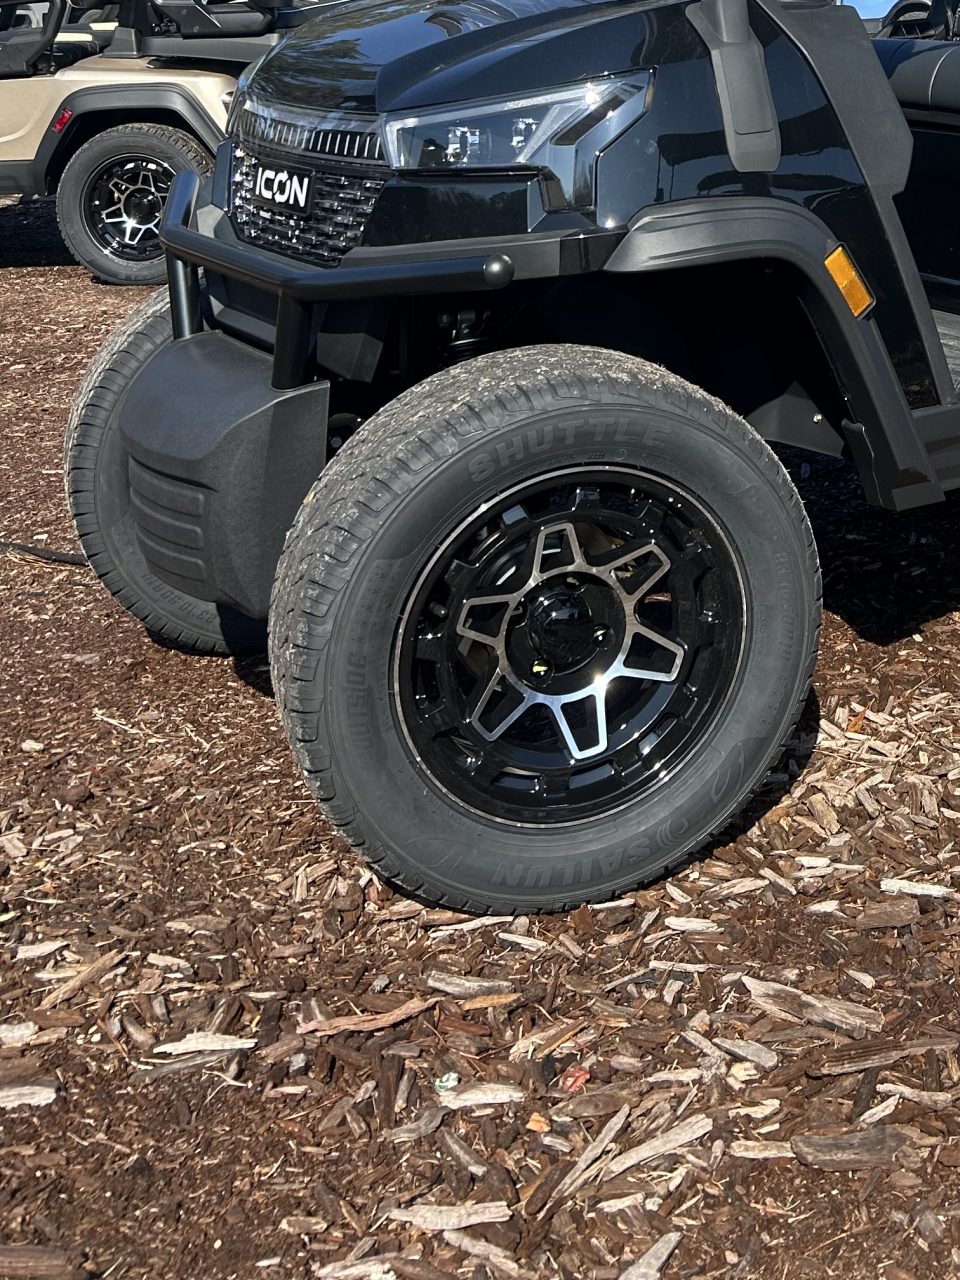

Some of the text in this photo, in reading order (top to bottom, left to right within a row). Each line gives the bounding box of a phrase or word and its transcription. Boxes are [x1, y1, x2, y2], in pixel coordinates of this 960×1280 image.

[255, 167, 309, 208] ICON
[467, 416, 673, 483] SHUTTLE
[489, 837, 653, 889] SAILUN
